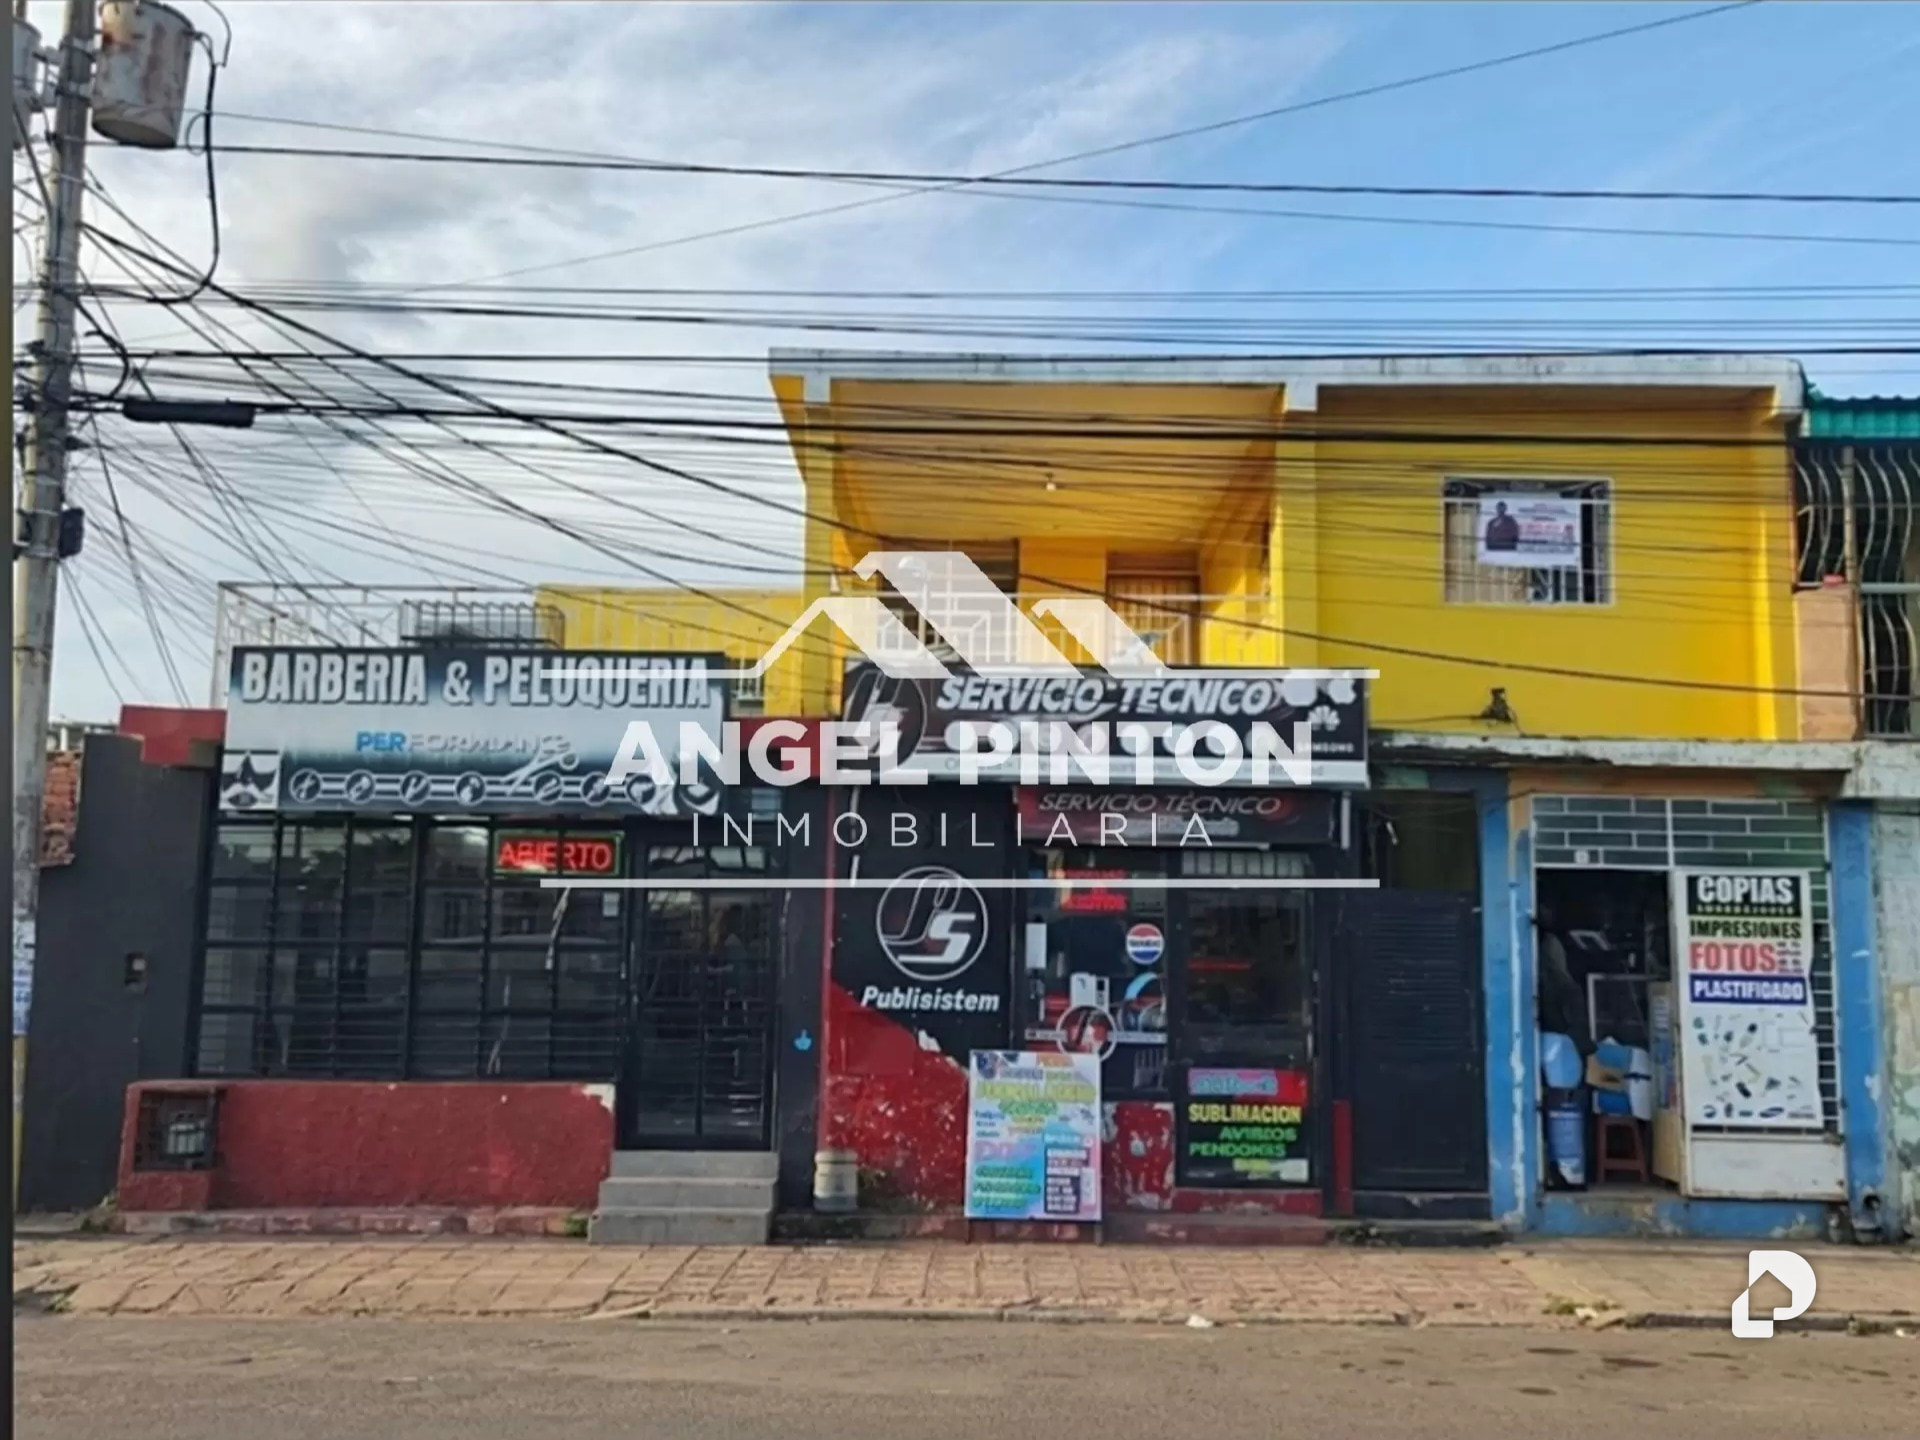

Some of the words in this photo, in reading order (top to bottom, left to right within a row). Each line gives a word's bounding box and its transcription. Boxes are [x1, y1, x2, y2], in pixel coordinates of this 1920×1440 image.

[242, 652, 428, 704] BARBERIA
[442, 660, 474, 705] &
[484, 655, 711, 709] PELUQUERIA
[936, 676, 1106, 714] SERVICIO
[1039, 792, 1157, 813] SERVICIO
[1166, 790, 1281, 815] TÉCNICO
[498, 841, 613, 870] ABIERTO
[1697, 876, 1794, 905] COPIAS
[1689, 920, 1802, 939] IMPRESIONES
[1689, 941, 1777, 972] FOTOS
[861, 984, 1001, 1012] Publisistem
[1693, 980, 1805, 1001] PLASTIFICADO
